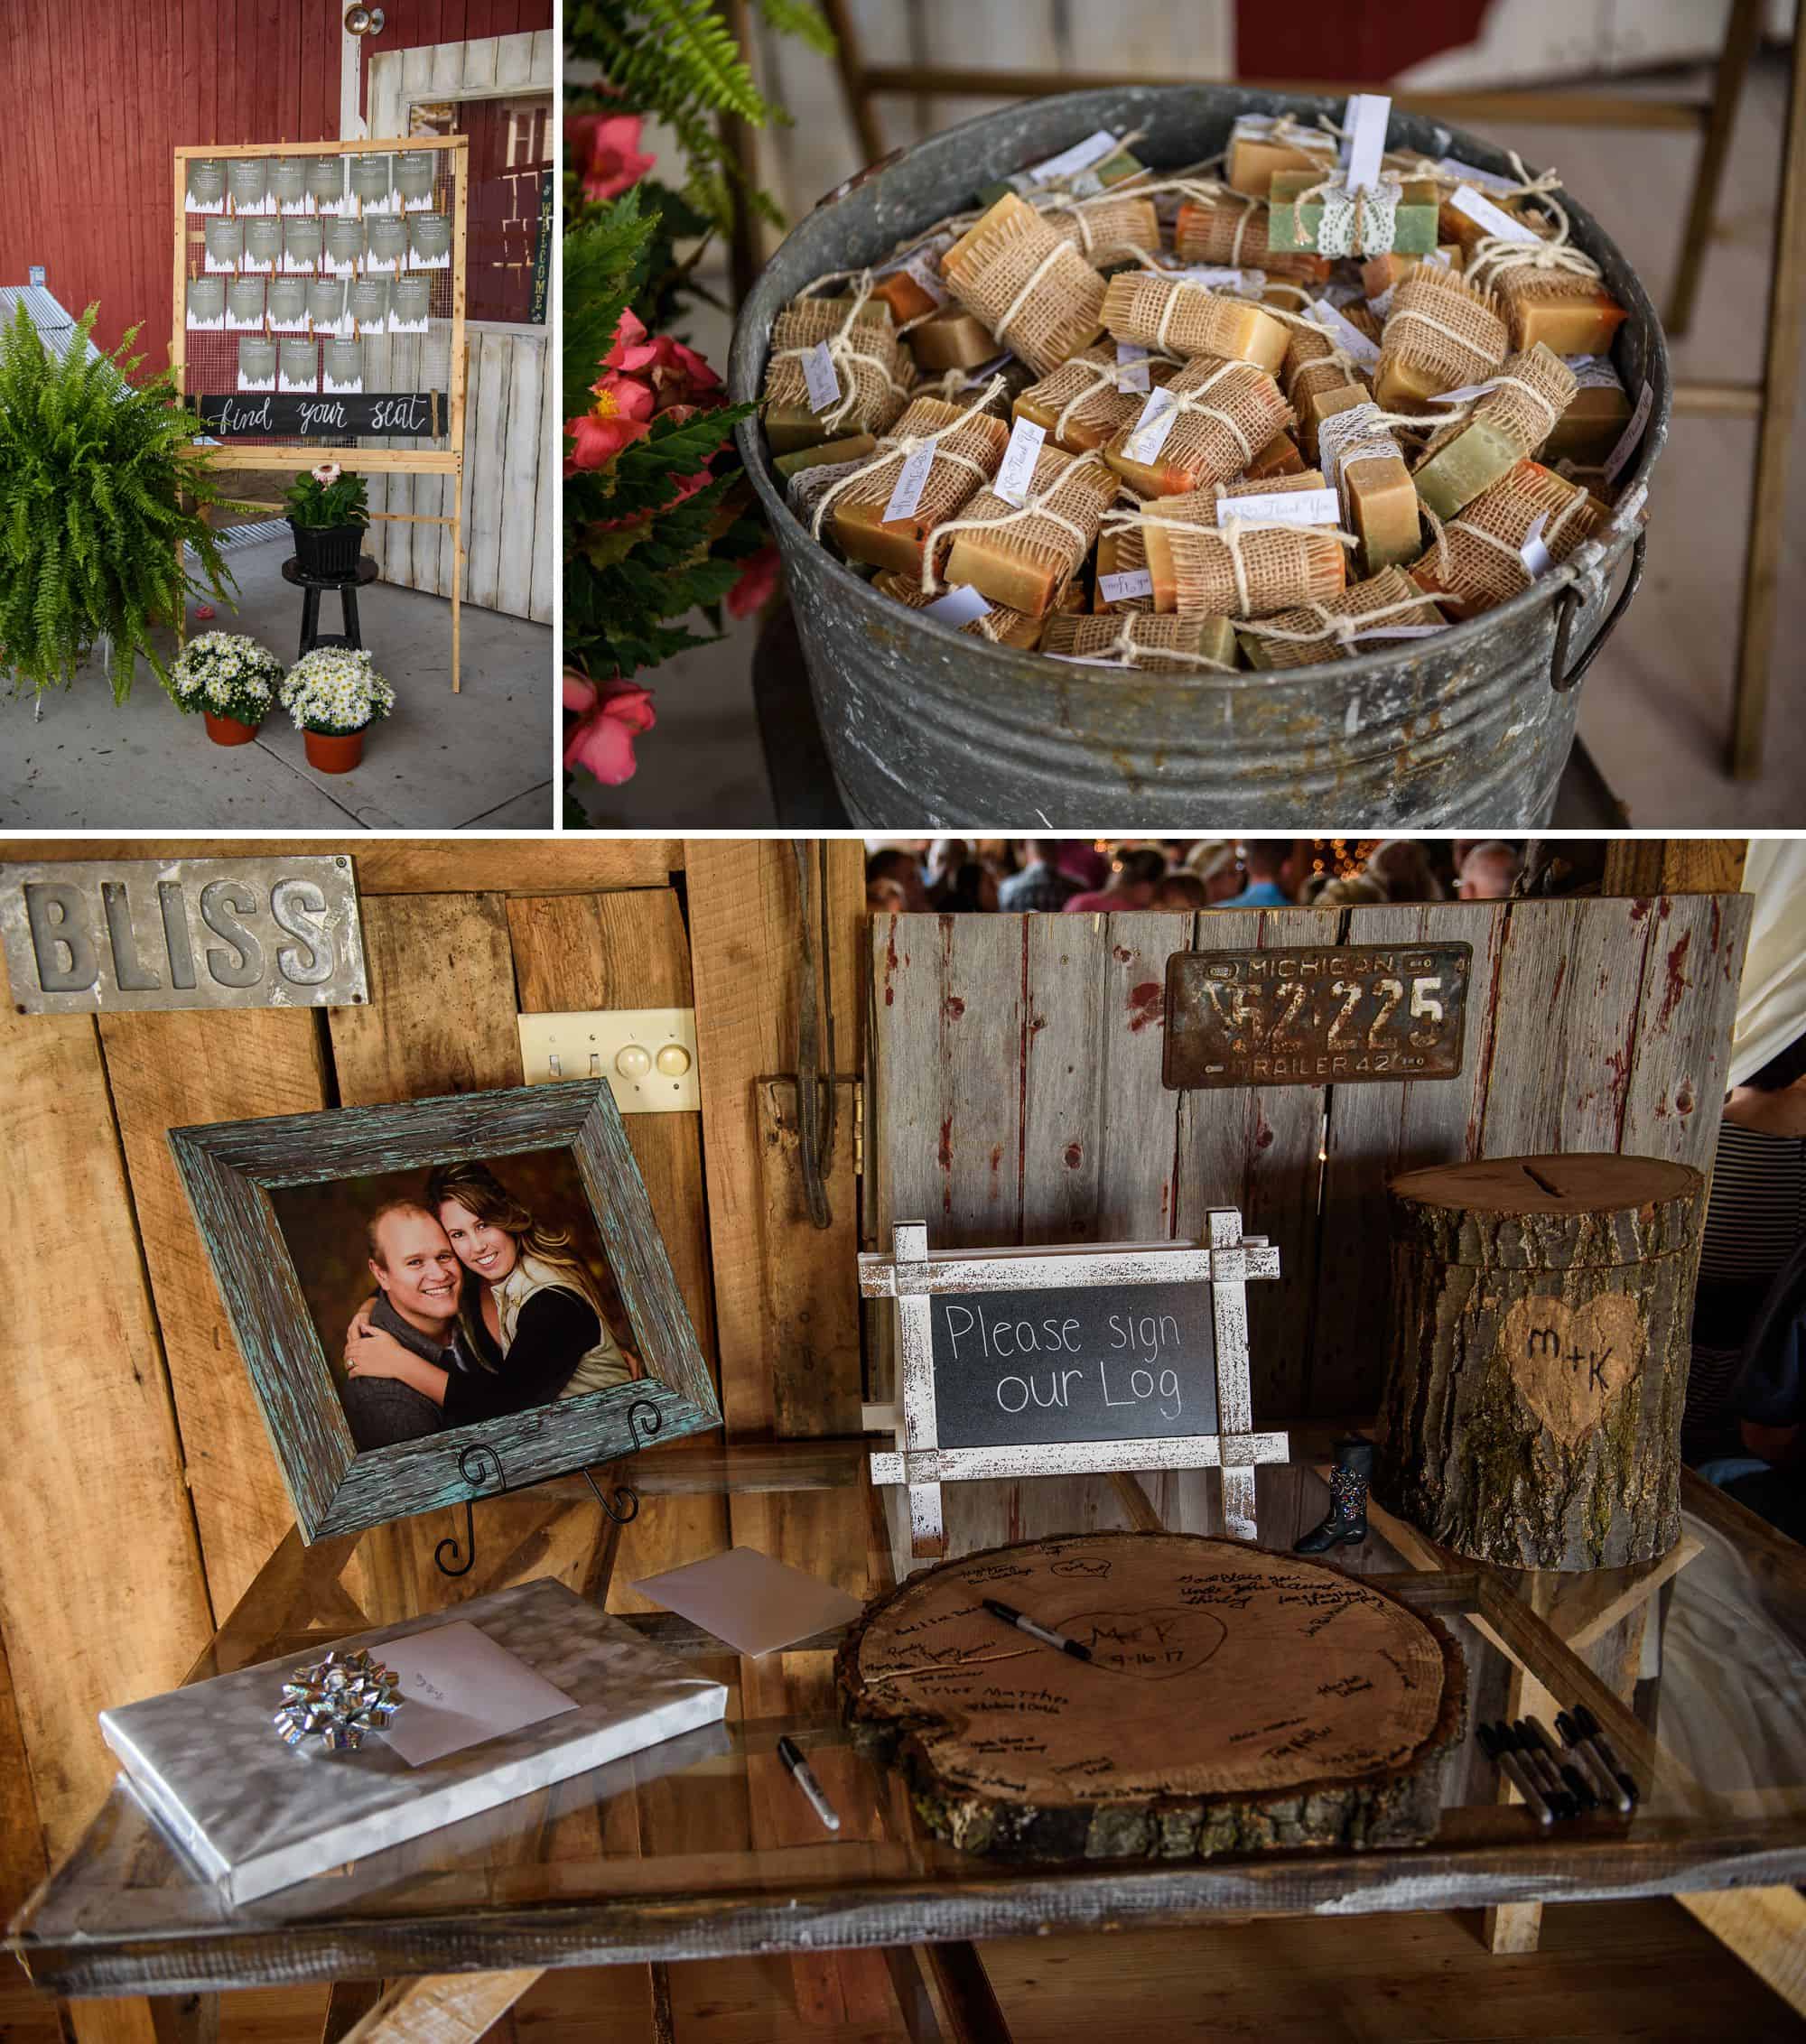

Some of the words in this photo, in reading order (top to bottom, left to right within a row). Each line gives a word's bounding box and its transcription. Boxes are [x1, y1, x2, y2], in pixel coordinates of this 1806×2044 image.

[535, 201, 551, 310] WELCOME
[207, 397, 272, 434] find
[297, 400, 347, 433] your
[369, 395, 426, 429] seat
[23, 878, 334, 992] BLISS
[1249, 954, 1394, 978] MICHIGAN
[1234, 1056, 1347, 1075] TRAILER
[945, 1305, 1082, 1359] Please
[1108, 1307, 1181, 1363] sign
[996, 1369, 1084, 1413] our
[1100, 1360, 1183, 1420] Log
